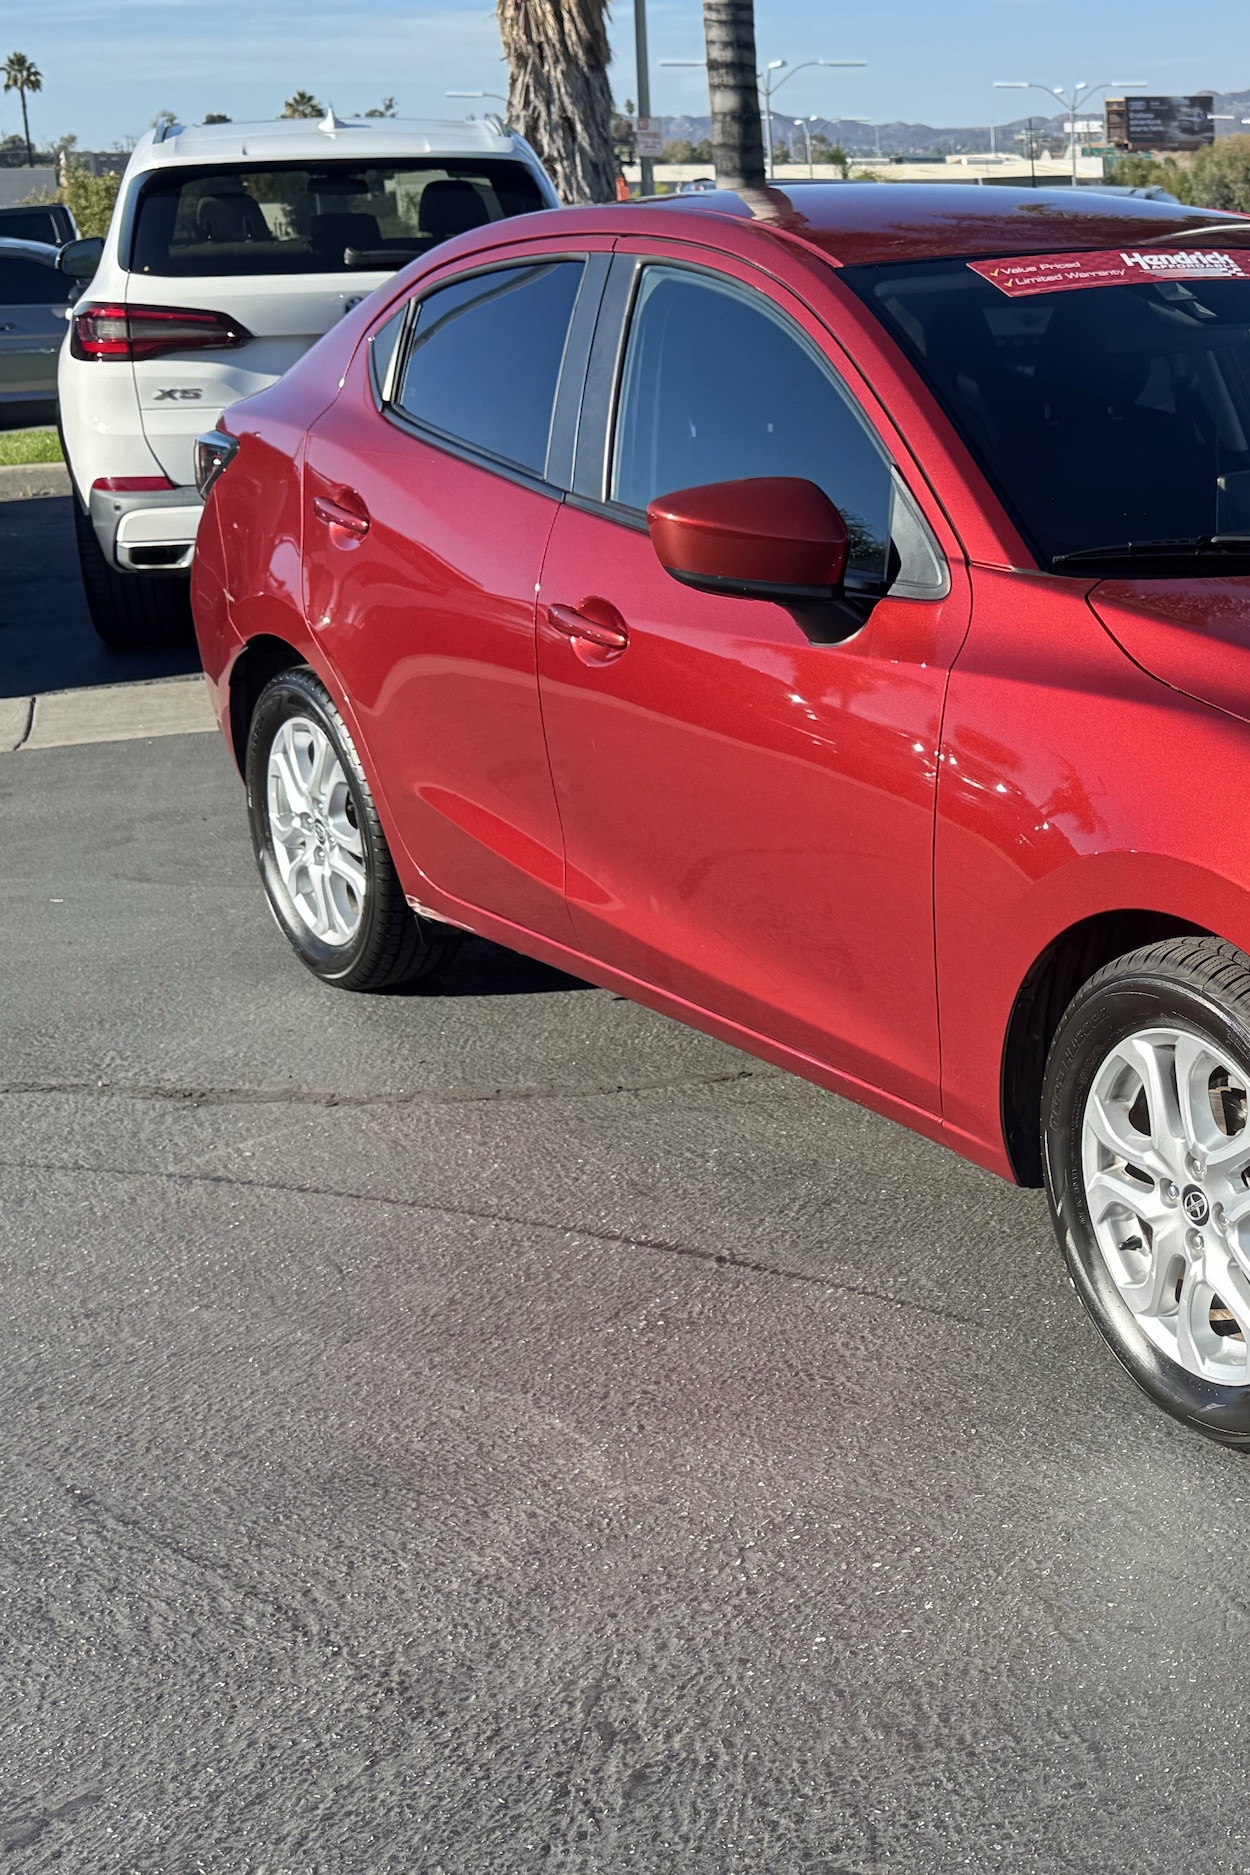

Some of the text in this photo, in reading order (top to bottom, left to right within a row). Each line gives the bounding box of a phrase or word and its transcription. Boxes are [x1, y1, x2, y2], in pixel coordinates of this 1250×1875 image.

[1000, 261, 1082, 276] Value Priced
[1120, 251, 1238, 270] Hendrick
[1015, 268, 1126, 286] Limited Warranty
[153, 388, 203, 401] X5
